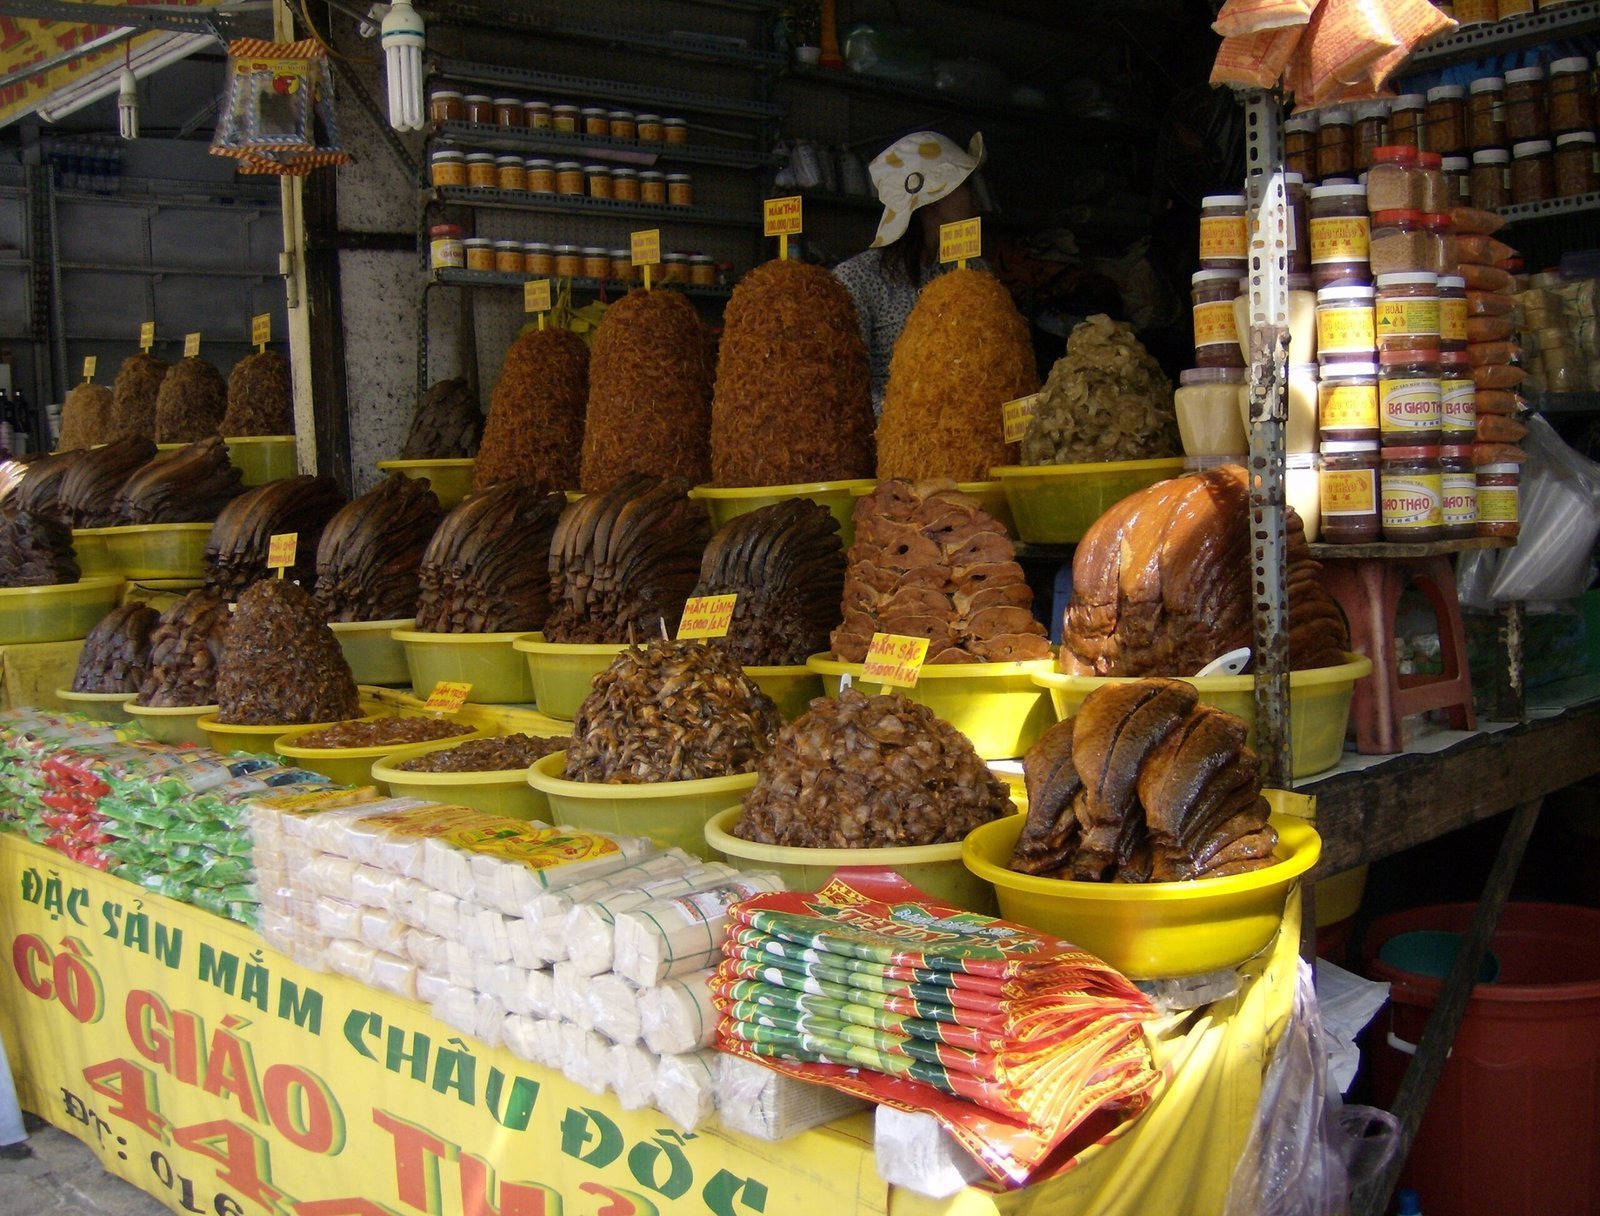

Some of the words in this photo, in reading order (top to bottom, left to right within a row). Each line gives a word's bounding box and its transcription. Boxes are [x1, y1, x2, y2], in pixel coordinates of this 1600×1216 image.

[12, 933, 105, 1025] CÔ
[125, 989, 347, 1157] GIÁO
[21, 867, 90, 927] ĐẶC
[102, 899, 183, 970] SẢN
[198, 949, 324, 1036] MẮM
[343, 1009, 540, 1131] CHÂU
[561, 1106, 769, 1216] ĐỐC
[60, 1086, 128, 1161] ĐT:
